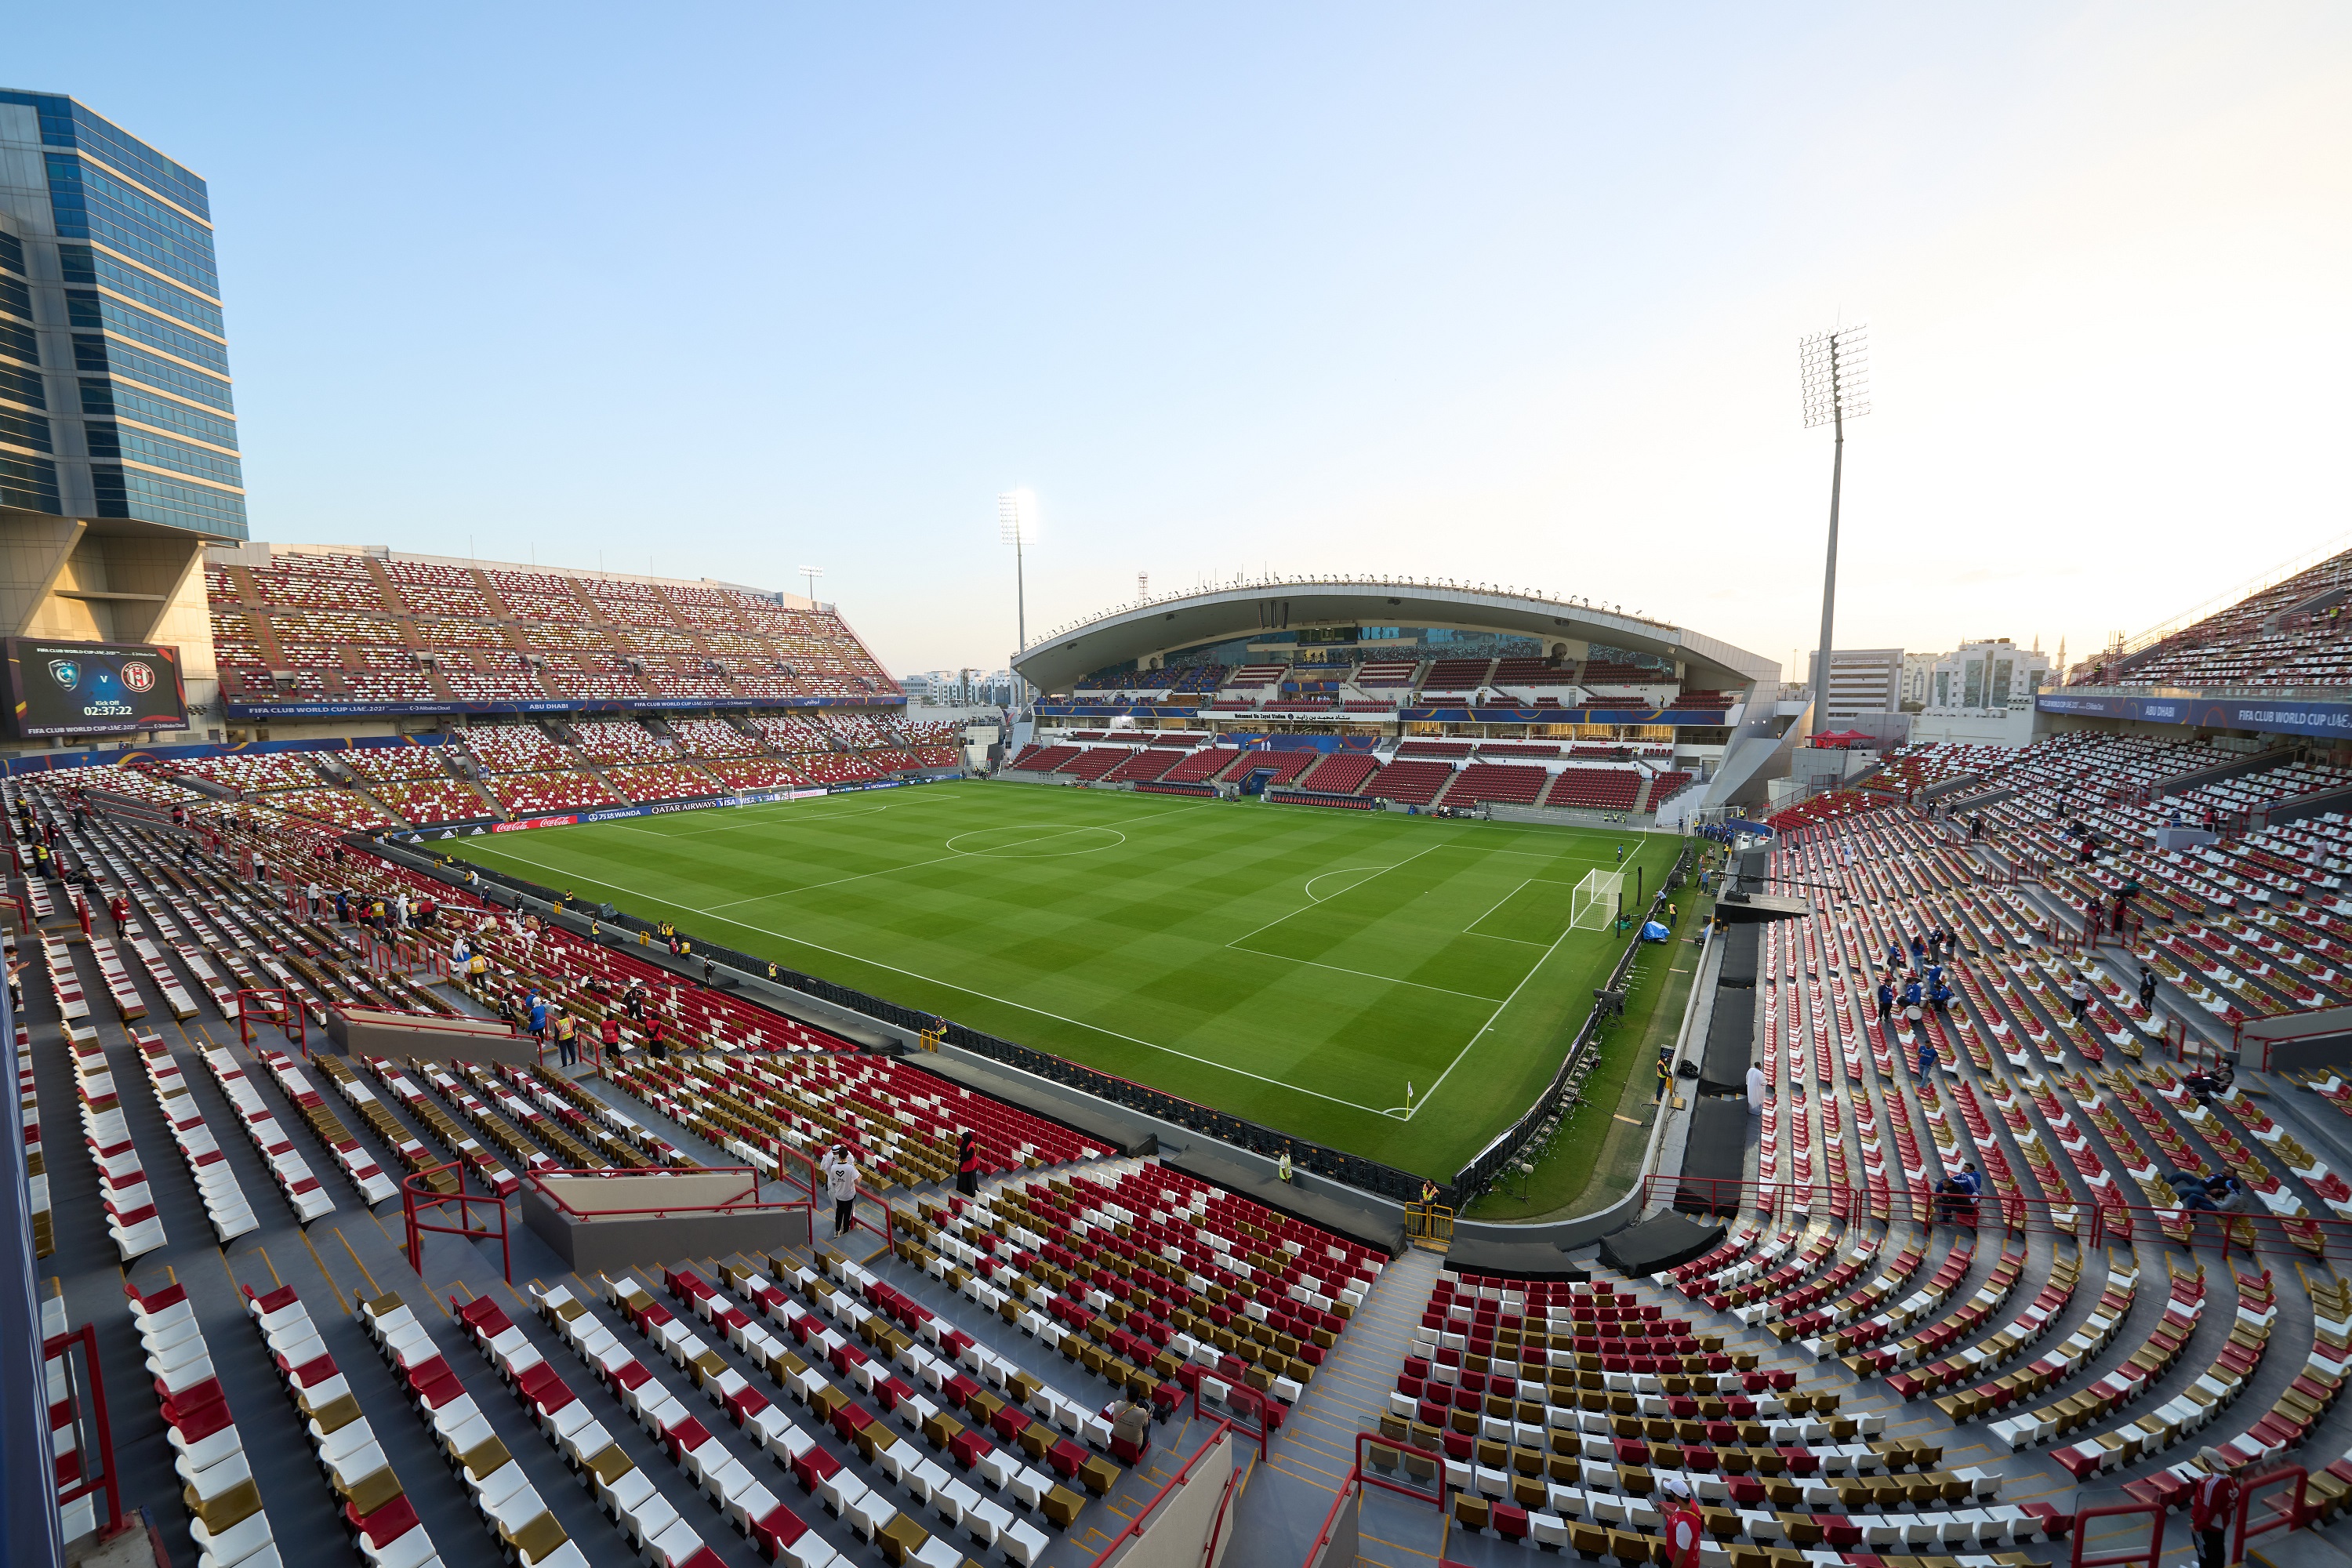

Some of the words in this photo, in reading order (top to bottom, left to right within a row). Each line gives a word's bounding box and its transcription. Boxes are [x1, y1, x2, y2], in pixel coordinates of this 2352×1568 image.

[84, 706, 132, 715] 02:37:22
[2145, 706, 2156, 716] ABU
[2157, 706, 2175, 717] DHABI
[2238, 710, 2253, 721] FIFA
[2254, 711, 2274, 722] CLUB
[2275, 712, 2306, 724] WORLD
[2307, 713, 2327, 726] CUP
[652, 803, 681, 815] QATAR
[682, 800, 717, 811] AIRWAYS
[496, 821, 528, 833] Coca-Cola
[540, 815, 569, 828] Coca-Cola
